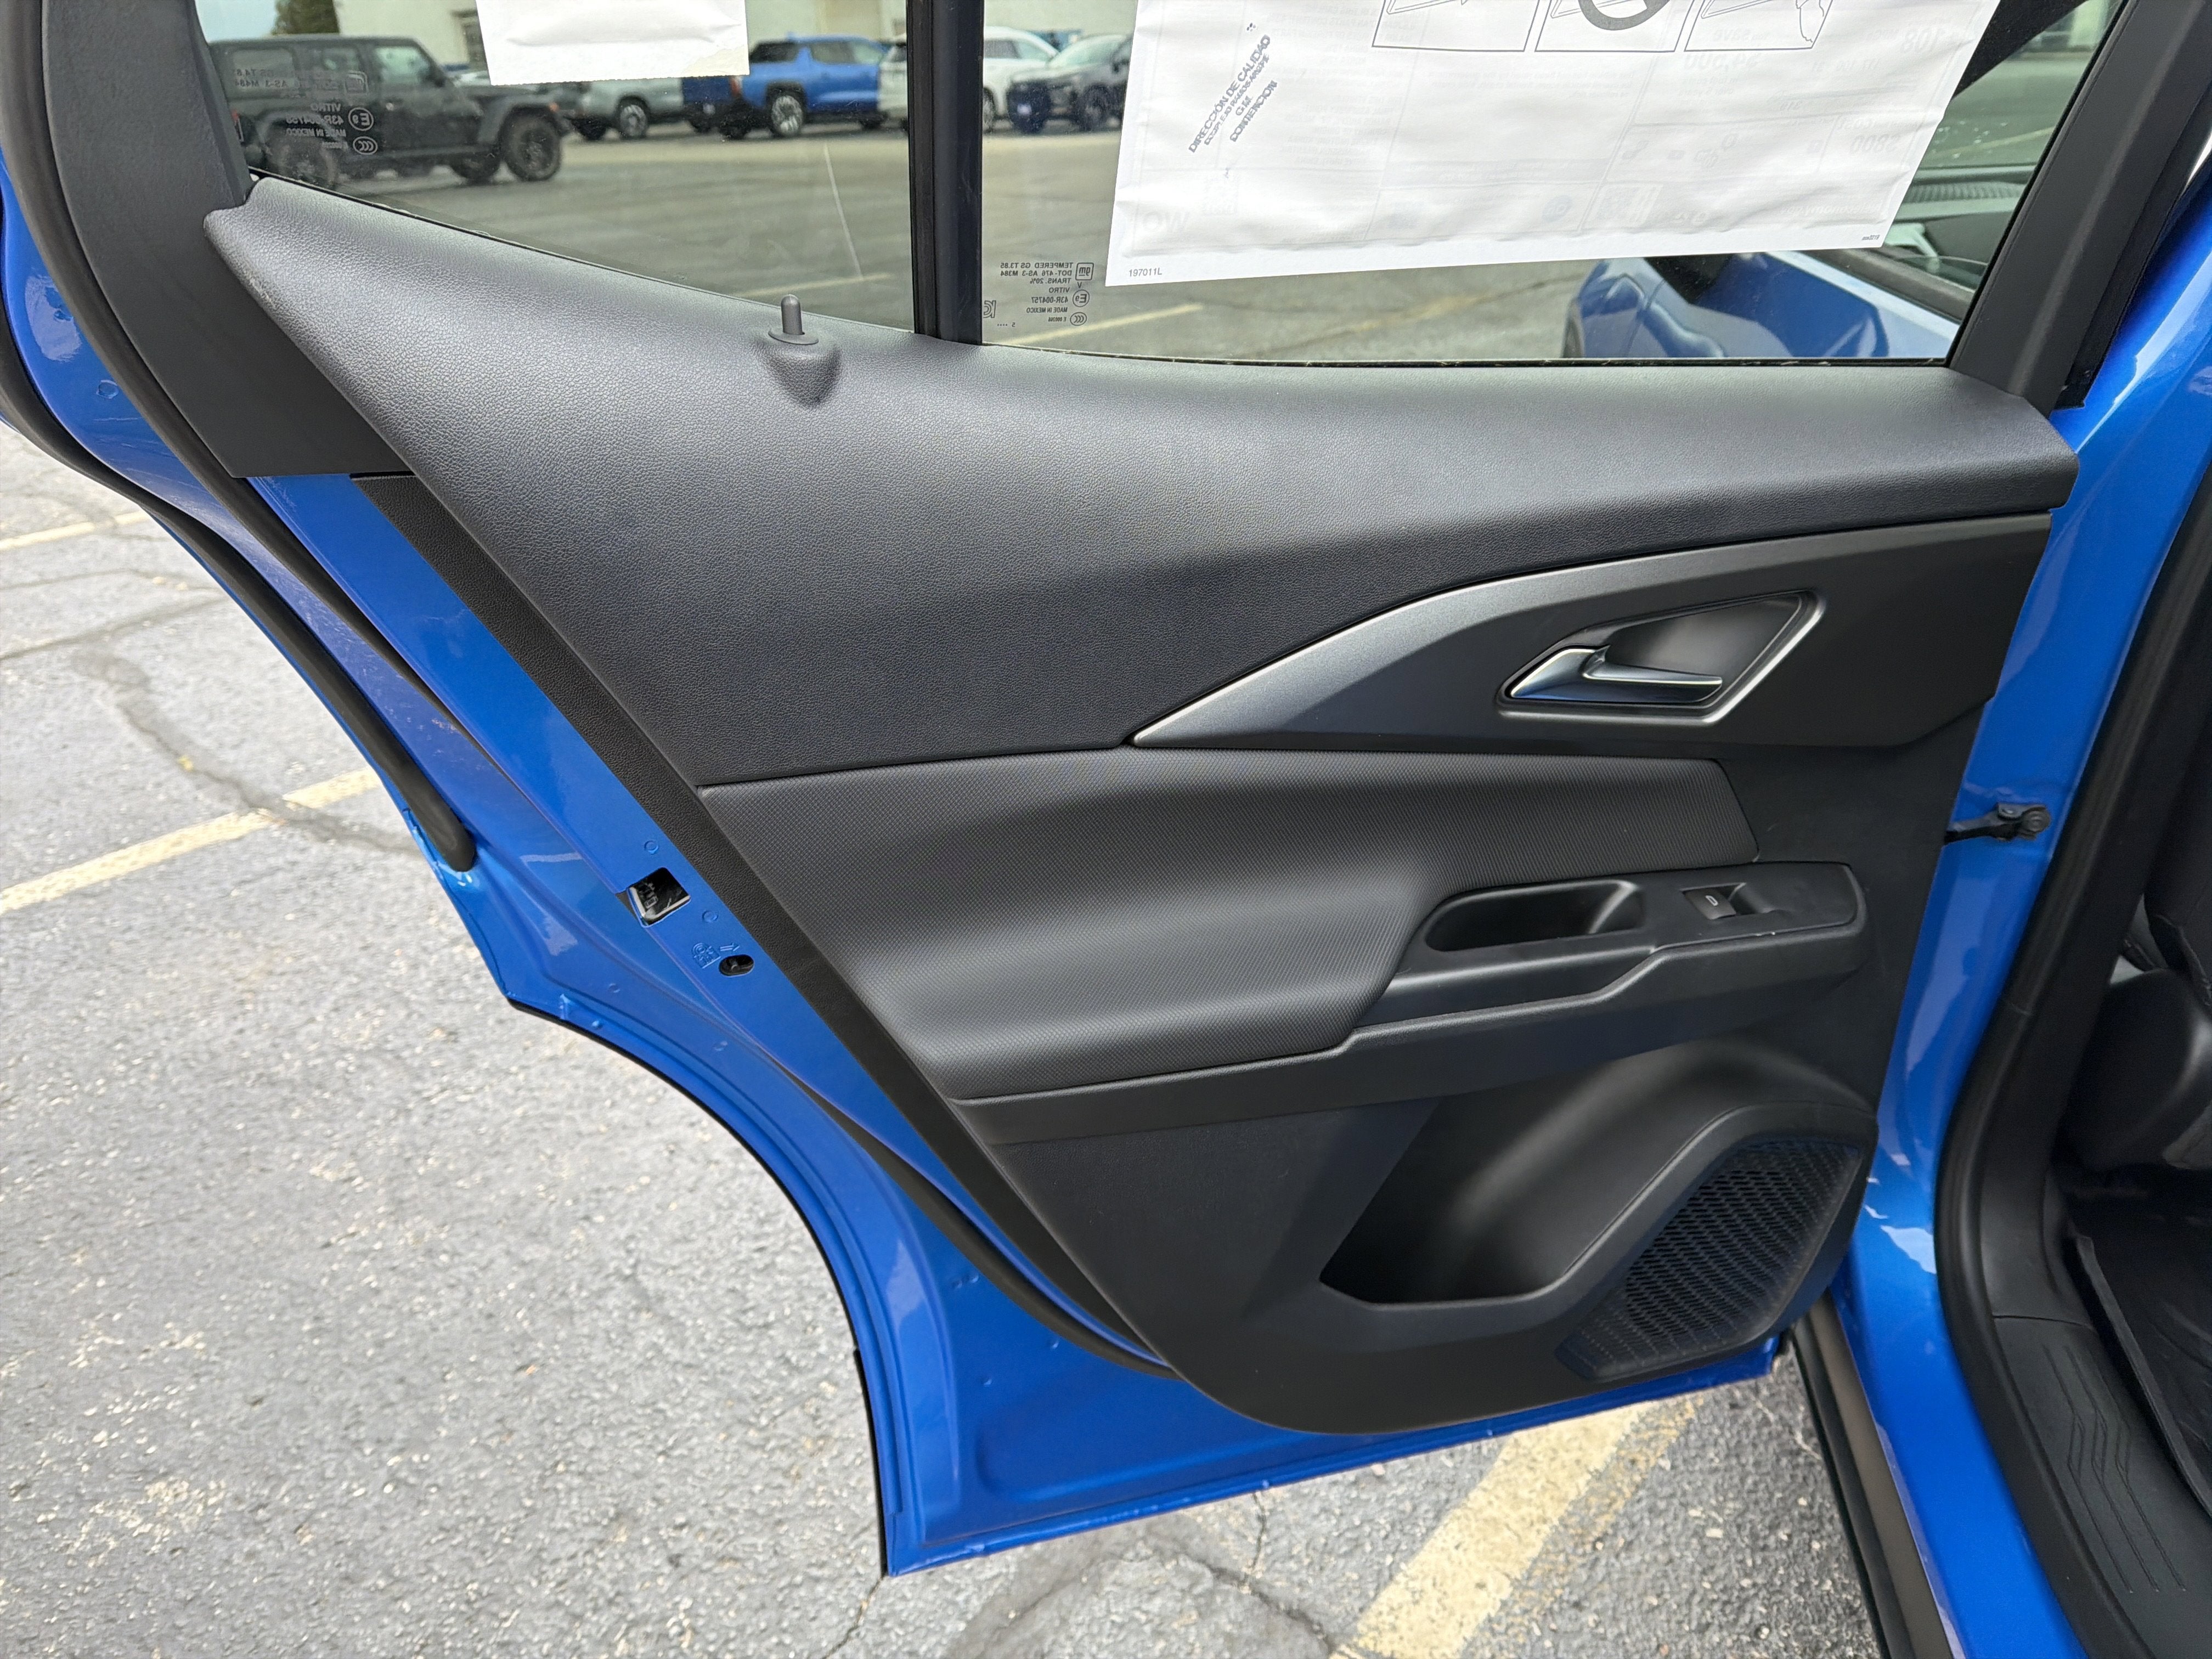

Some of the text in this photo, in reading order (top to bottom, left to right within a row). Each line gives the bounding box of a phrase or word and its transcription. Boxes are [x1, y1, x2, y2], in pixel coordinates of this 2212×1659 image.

[1226, 80, 1240, 98] DE
[1238, 34, 1271, 82] CALIDAD
[1128, 267, 1163, 277] 197011L
